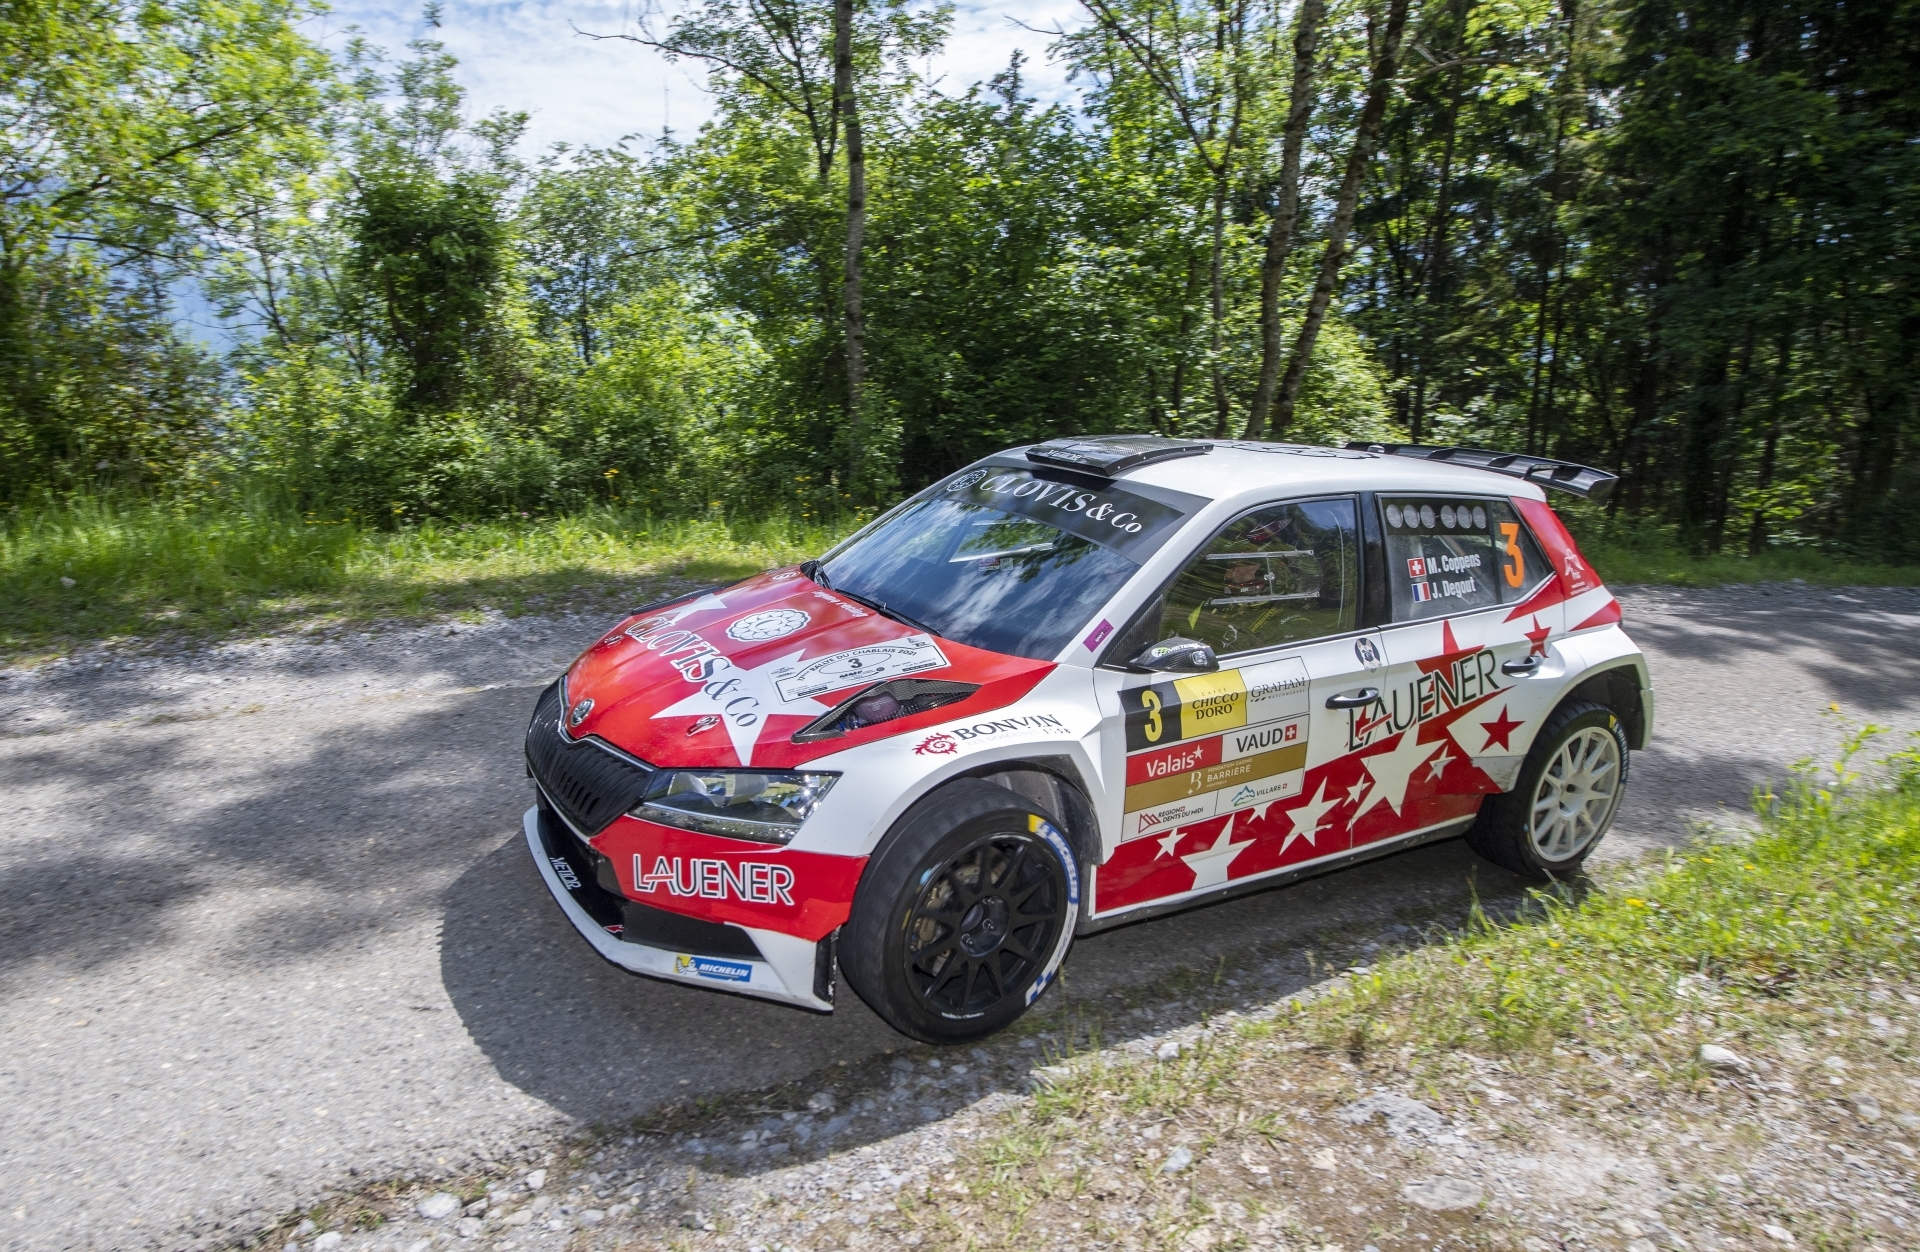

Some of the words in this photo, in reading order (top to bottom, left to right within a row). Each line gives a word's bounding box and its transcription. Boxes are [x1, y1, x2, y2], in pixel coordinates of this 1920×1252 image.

[1426, 557, 1441, 574] M.
[1441, 554, 1481, 573] Coppens
[1500, 522, 1524, 588] 3
[1432, 582, 1442, 599] J.
[1442, 576, 1476, 598] Degout
[809, 658, 834, 671] RALLYE
[852, 648, 896, 656] CHABLAIS
[897, 649, 917, 657] 2021
[848, 658, 863, 668] 3
[1251, 676, 1306, 698] GRAHAM
[1192, 692, 1239, 709] CHICCO
[1196, 703, 1233, 720] D'ORO
[1349, 649, 1500, 752] LAUENER
[951, 714, 1063, 740] BONVIN
[1141, 690, 1163, 742] 3
[1236, 727, 1283, 753] VAUD
[1146, 752, 1195, 778] Valais
[1207, 762, 1235, 773] FONDATION
[1235, 758, 1253, 766] CASINO
[1256, 785, 1282, 797] VILLARS
[1162, 812, 1181, 823] DENTS
[1181, 810, 1191, 818] DU
[1190, 807, 1204, 816] MIDI
[633, 853, 795, 906] LAUENER
[698, 963, 749, 977] MICHELIN
